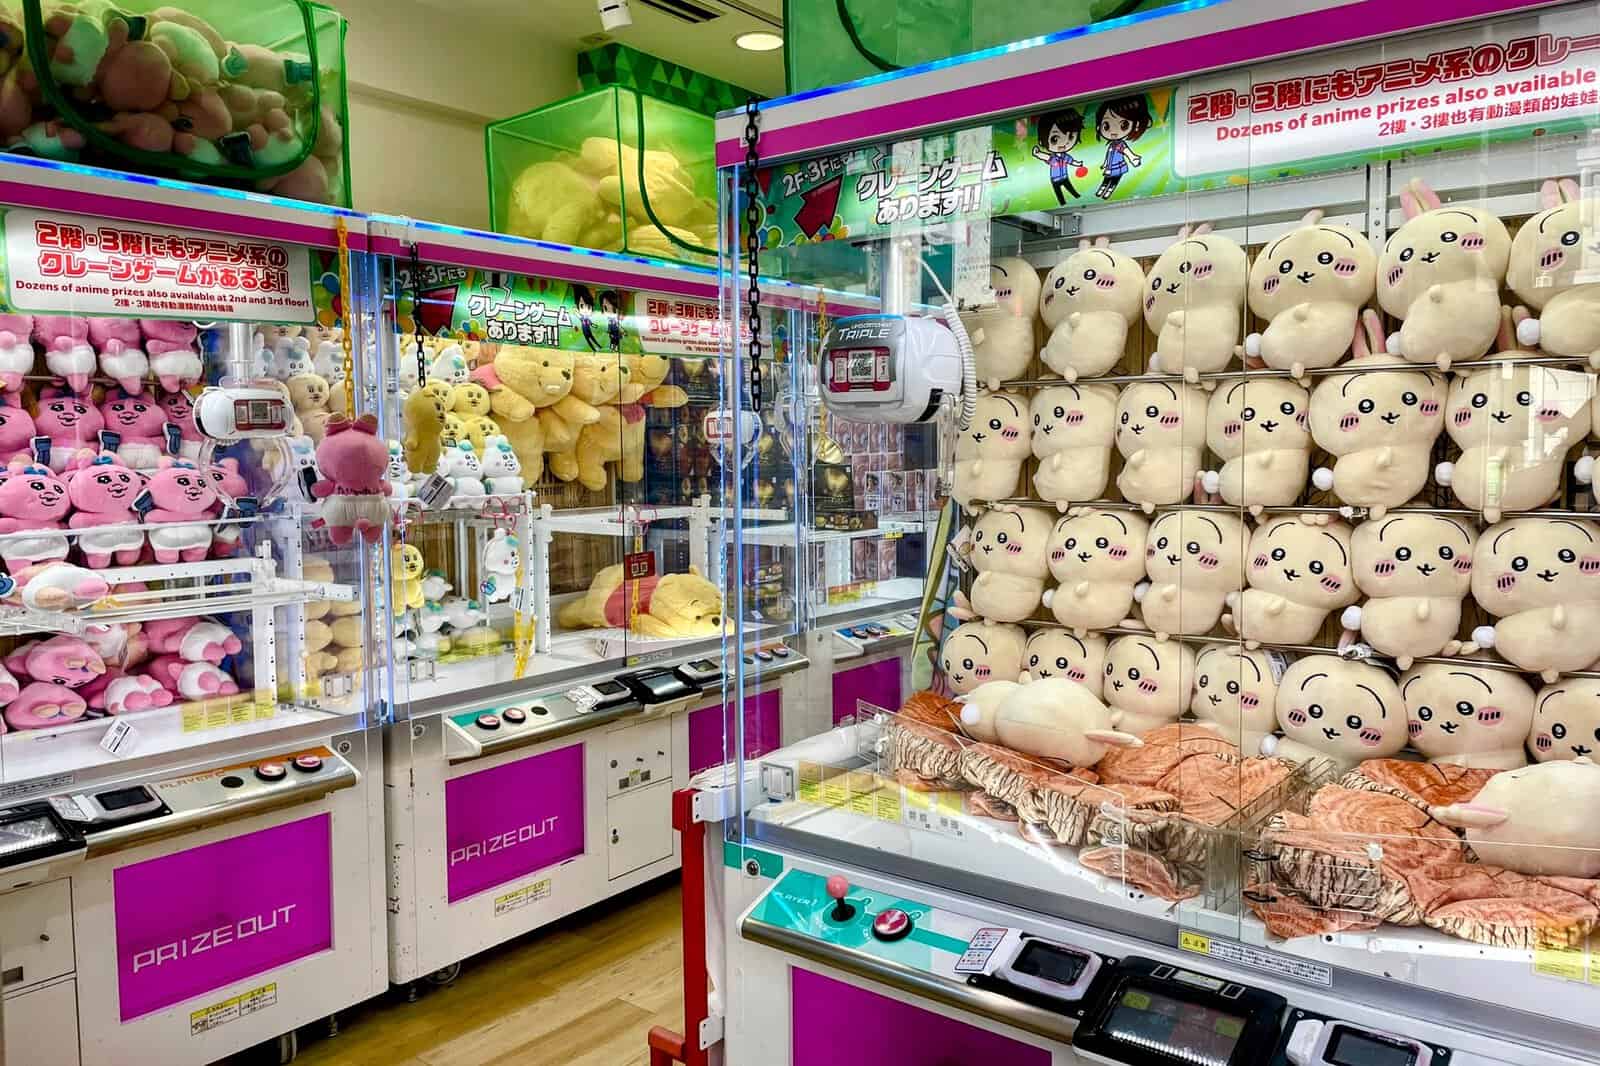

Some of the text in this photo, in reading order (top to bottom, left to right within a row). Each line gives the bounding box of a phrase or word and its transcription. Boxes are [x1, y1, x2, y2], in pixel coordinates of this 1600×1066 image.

[1217, 68, 1596, 141] Dozens of anime prizes also available
[857, 151, 1008, 200] クレーンゲーム
[16, 280, 59, 291] Dozens
[61, 283, 72, 292] of
[75, 285, 109, 295] anime
[112, 287, 145, 298] prizes
[147, 288, 168, 298] also
[170, 291, 215, 301] available
[217, 294, 227, 302] at
[229, 294, 247, 303] 2nd
[249, 296, 266, 305] and
[268, 296, 284, 305] 3rd
[468, 295, 573, 327] クレーンゲーム
[838, 327, 892, 341] TRIPLE
